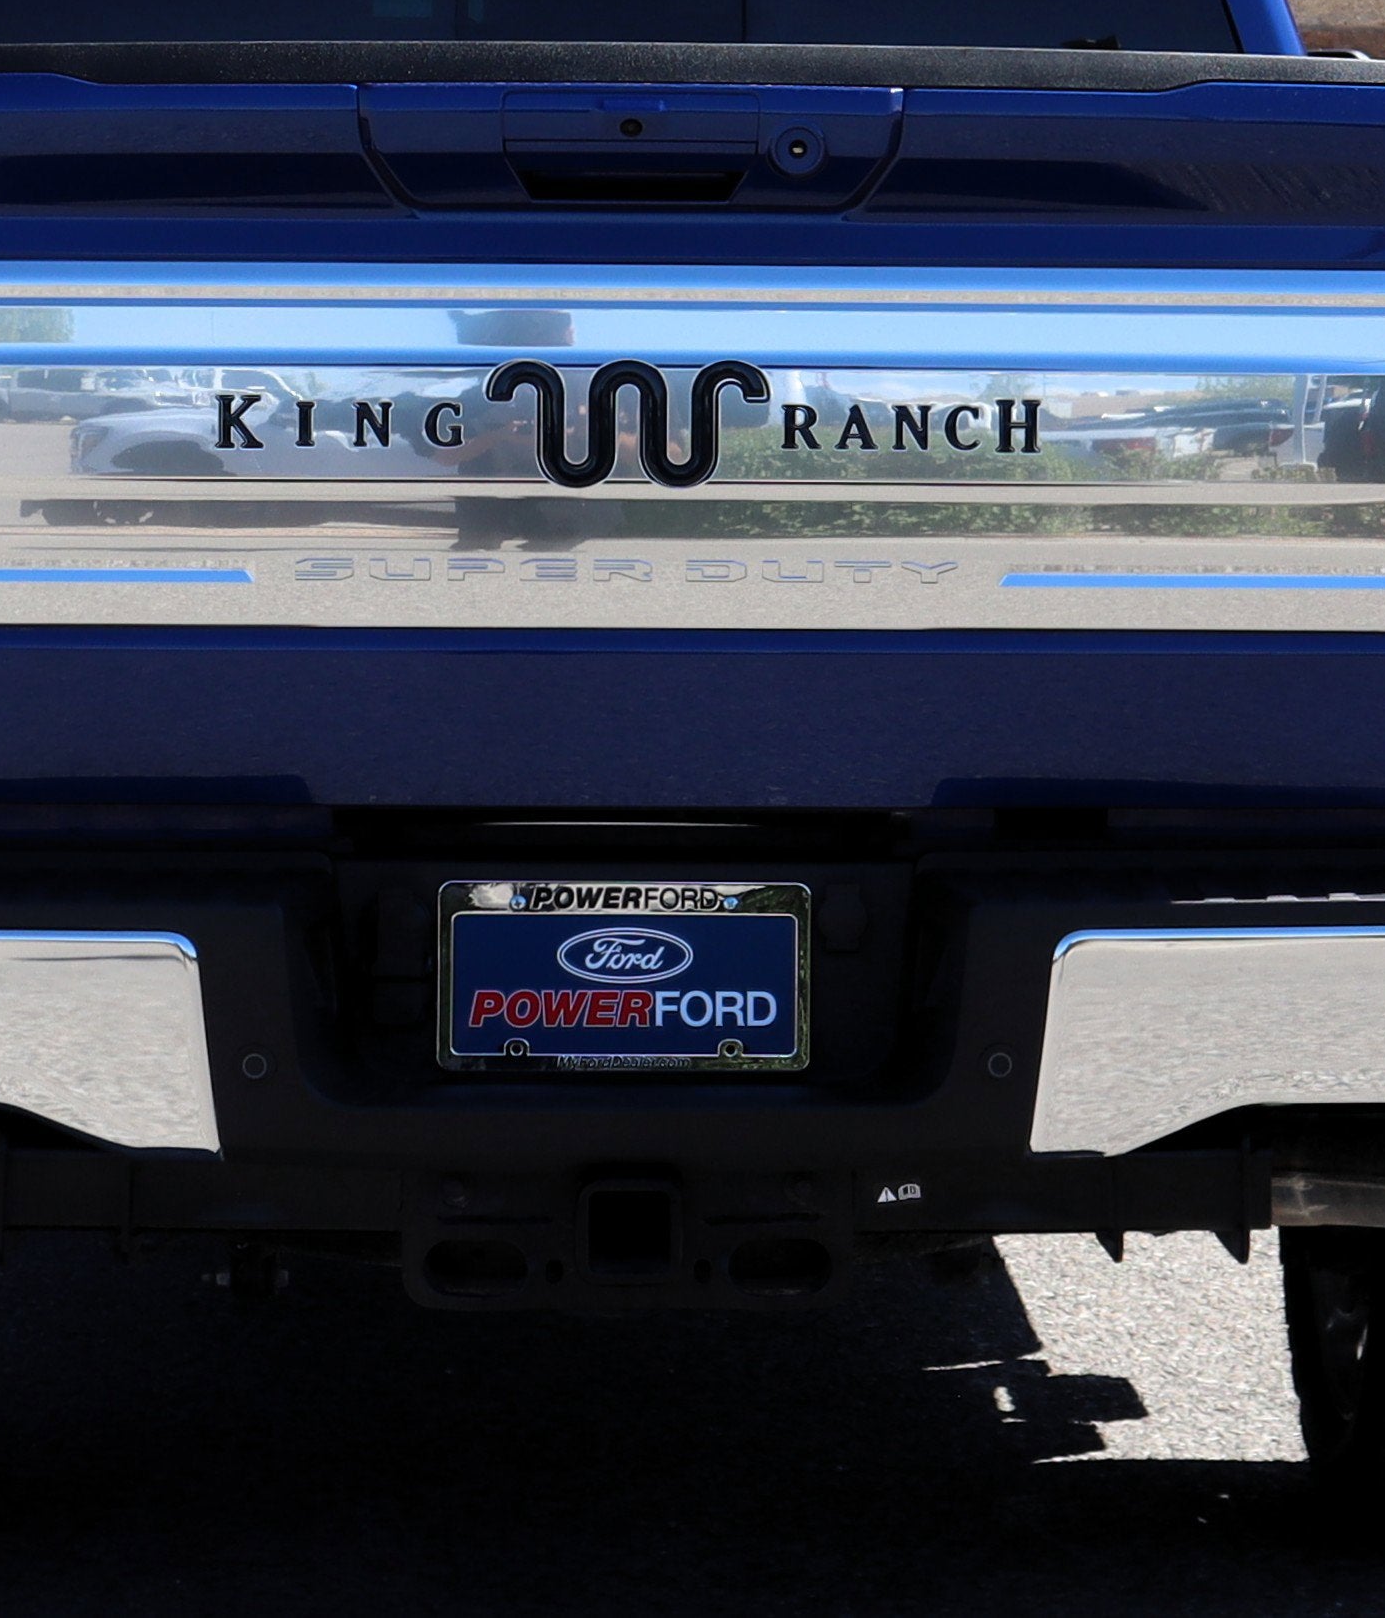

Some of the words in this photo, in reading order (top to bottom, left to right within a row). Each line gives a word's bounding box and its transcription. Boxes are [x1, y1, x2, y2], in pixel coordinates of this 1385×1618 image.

[215, 393, 465, 451] KING
[780, 398, 1043, 453] RANCH
[294, 558, 653, 582] SUPER
[685, 559, 959, 584] DUTY
[532, 886, 719, 911] POWERFORD
[584, 937, 665, 971] Ford
[469, 990, 777, 1027] POWERFORD
[556, 1054, 691, 1069] MyFordDealer.com
